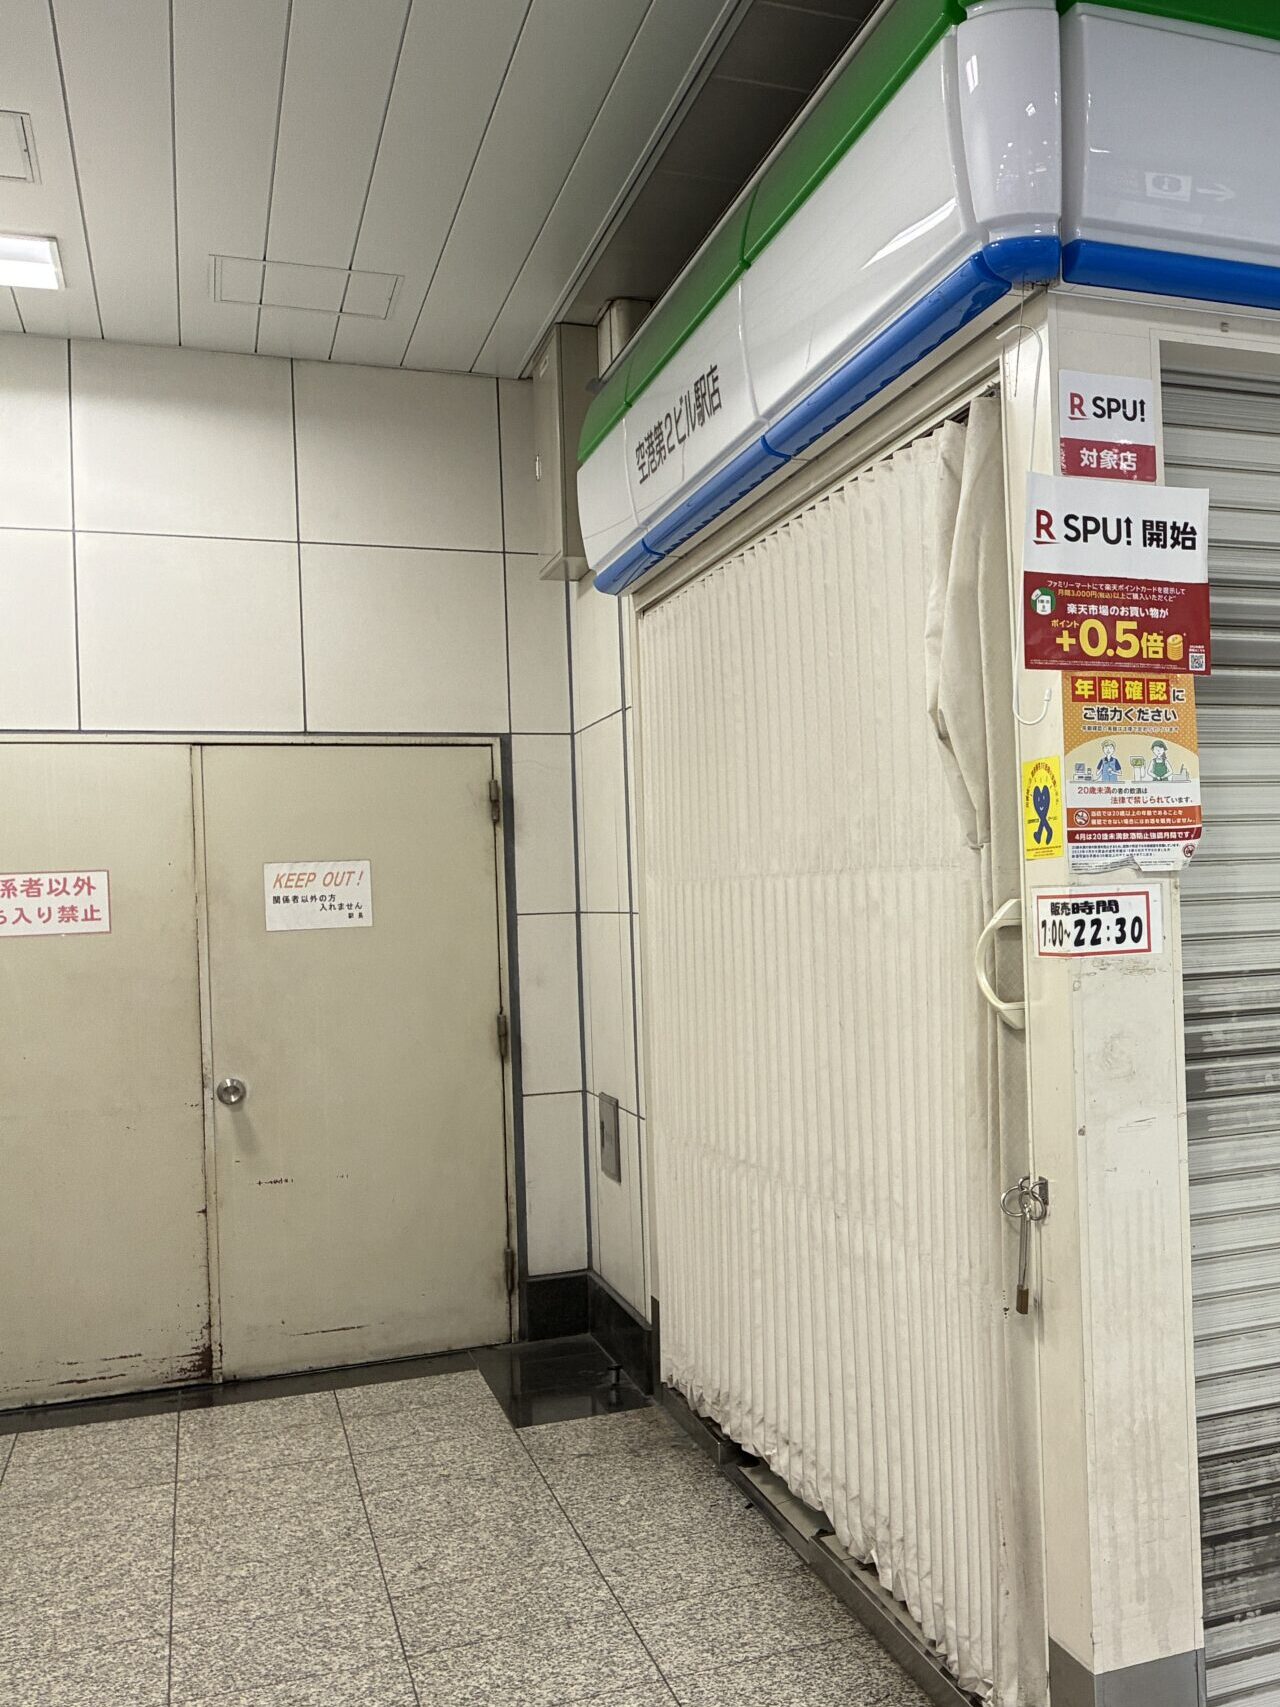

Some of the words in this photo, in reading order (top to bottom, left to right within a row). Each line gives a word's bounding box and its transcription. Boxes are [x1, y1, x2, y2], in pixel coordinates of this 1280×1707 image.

[635, 364, 722, 485] 空港第2ビル駅店
[1080, 447, 1137, 471] 対象店
[1142, 520, 1197, 550] 開始
[1067, 603, 1169, 618] 楽天市場のお買い物が
[1051, 619, 1079, 629] ポイント
[1083, 706, 1178, 722] ご協力ください
[273, 872, 316, 889] KEEP
[272, 894, 336, 904] 関係者以外の方
[320, 902, 362, 912] 入れません
[1050, 899, 1119, 916] 販売時間
